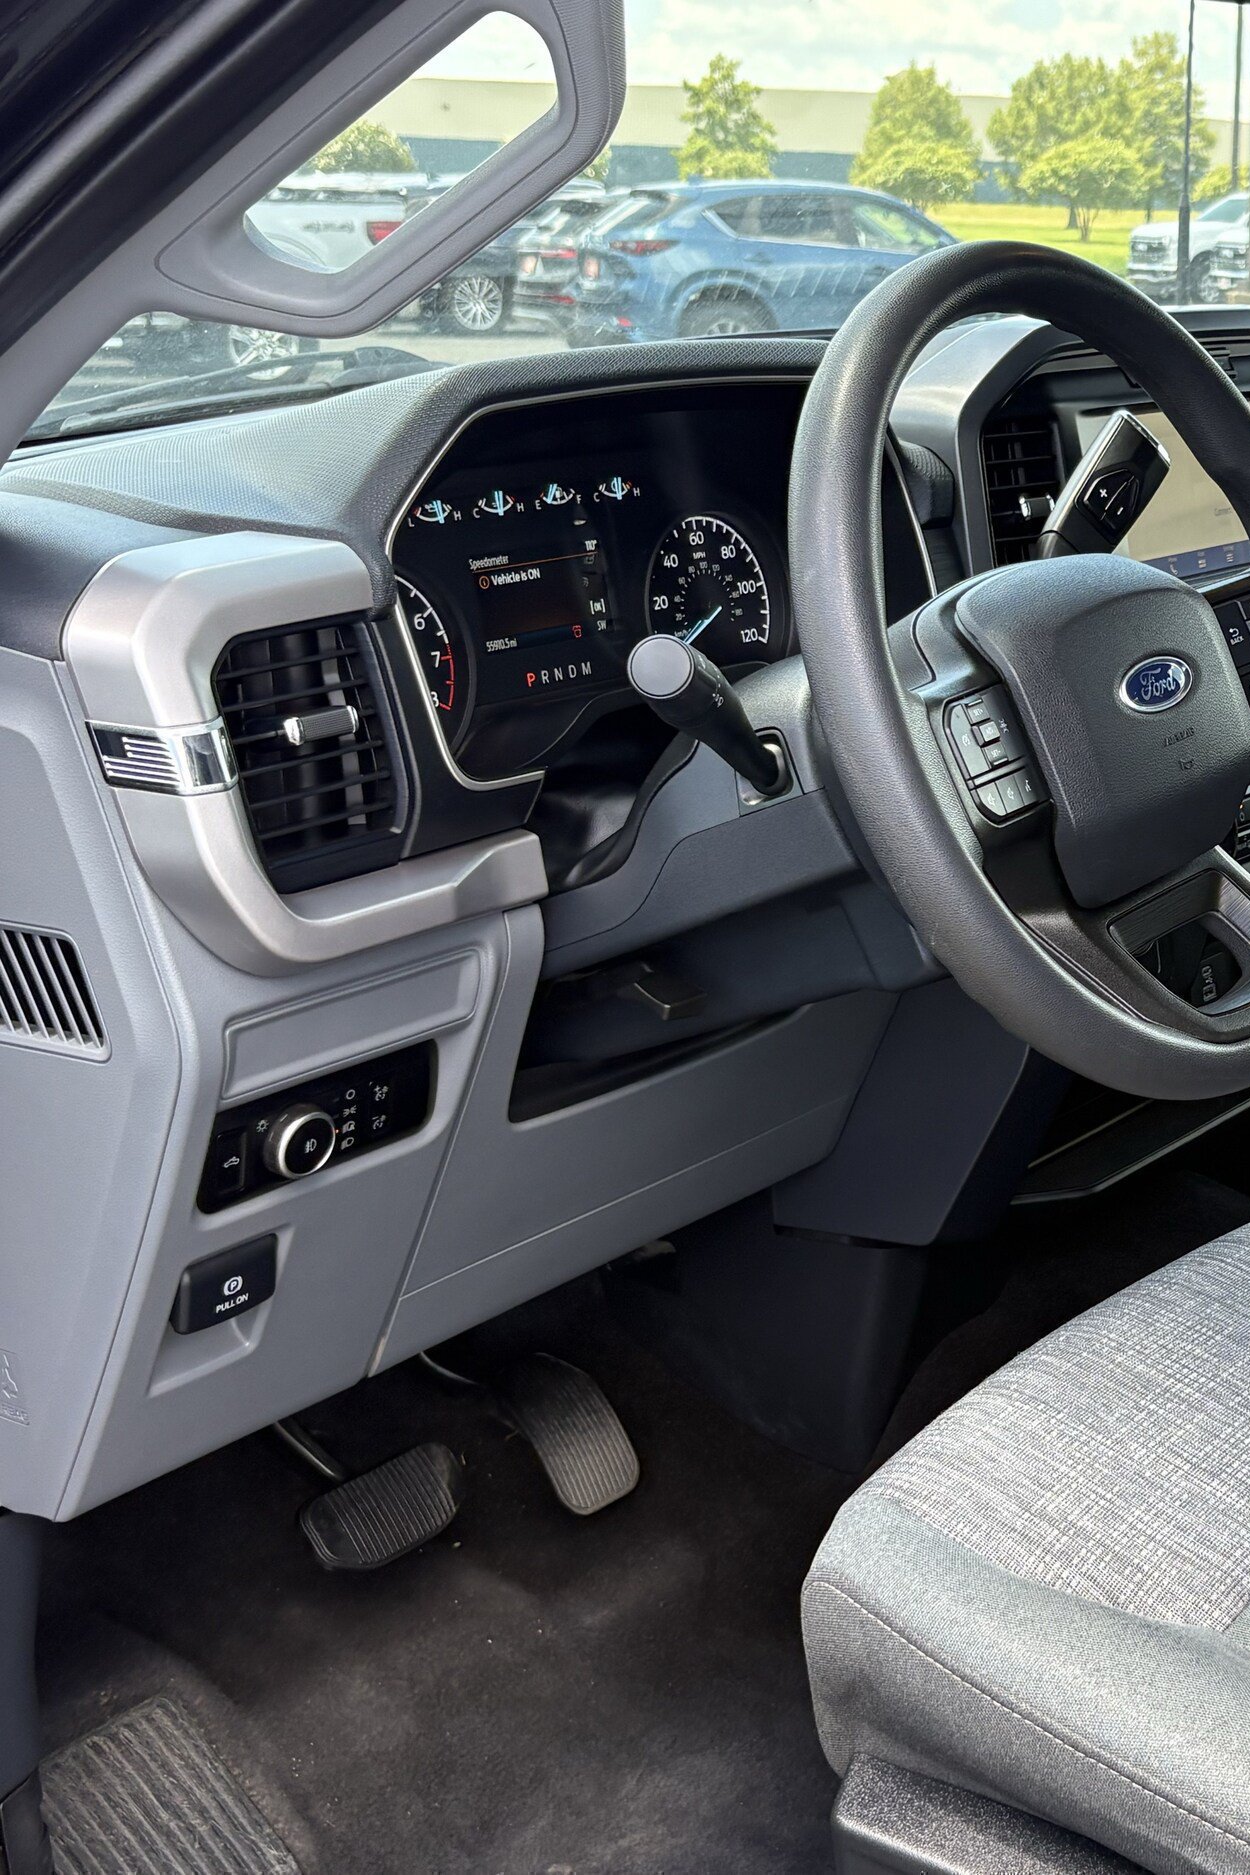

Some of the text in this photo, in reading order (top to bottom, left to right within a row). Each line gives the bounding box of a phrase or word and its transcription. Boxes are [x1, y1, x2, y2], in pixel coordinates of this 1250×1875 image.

[535, 494, 582, 510] E F
[594, 487, 640, 502] C H
[473, 502, 524, 518] C H
[408, 510, 462, 527] L H
[689, 531, 704, 545] 60
[693, 551, 706, 560] MPH
[721, 545, 736, 559] 80
[469, 555, 509, 570] Speedometer
[663, 554, 679, 568] 40
[491, 568, 541, 586] Vehicle is ON
[737, 580, 756, 595] 100
[653, 596, 669, 610] 20
[413, 613, 426, 630] 6
[597, 620, 607, 631] SW
[741, 628, 758, 643] 120
[430, 651, 441, 668] 7
[526, 661, 592, 687] P R N D M
[1140, 668, 1176, 700] Ford
[216, 1293, 249, 1313] PULL ON
